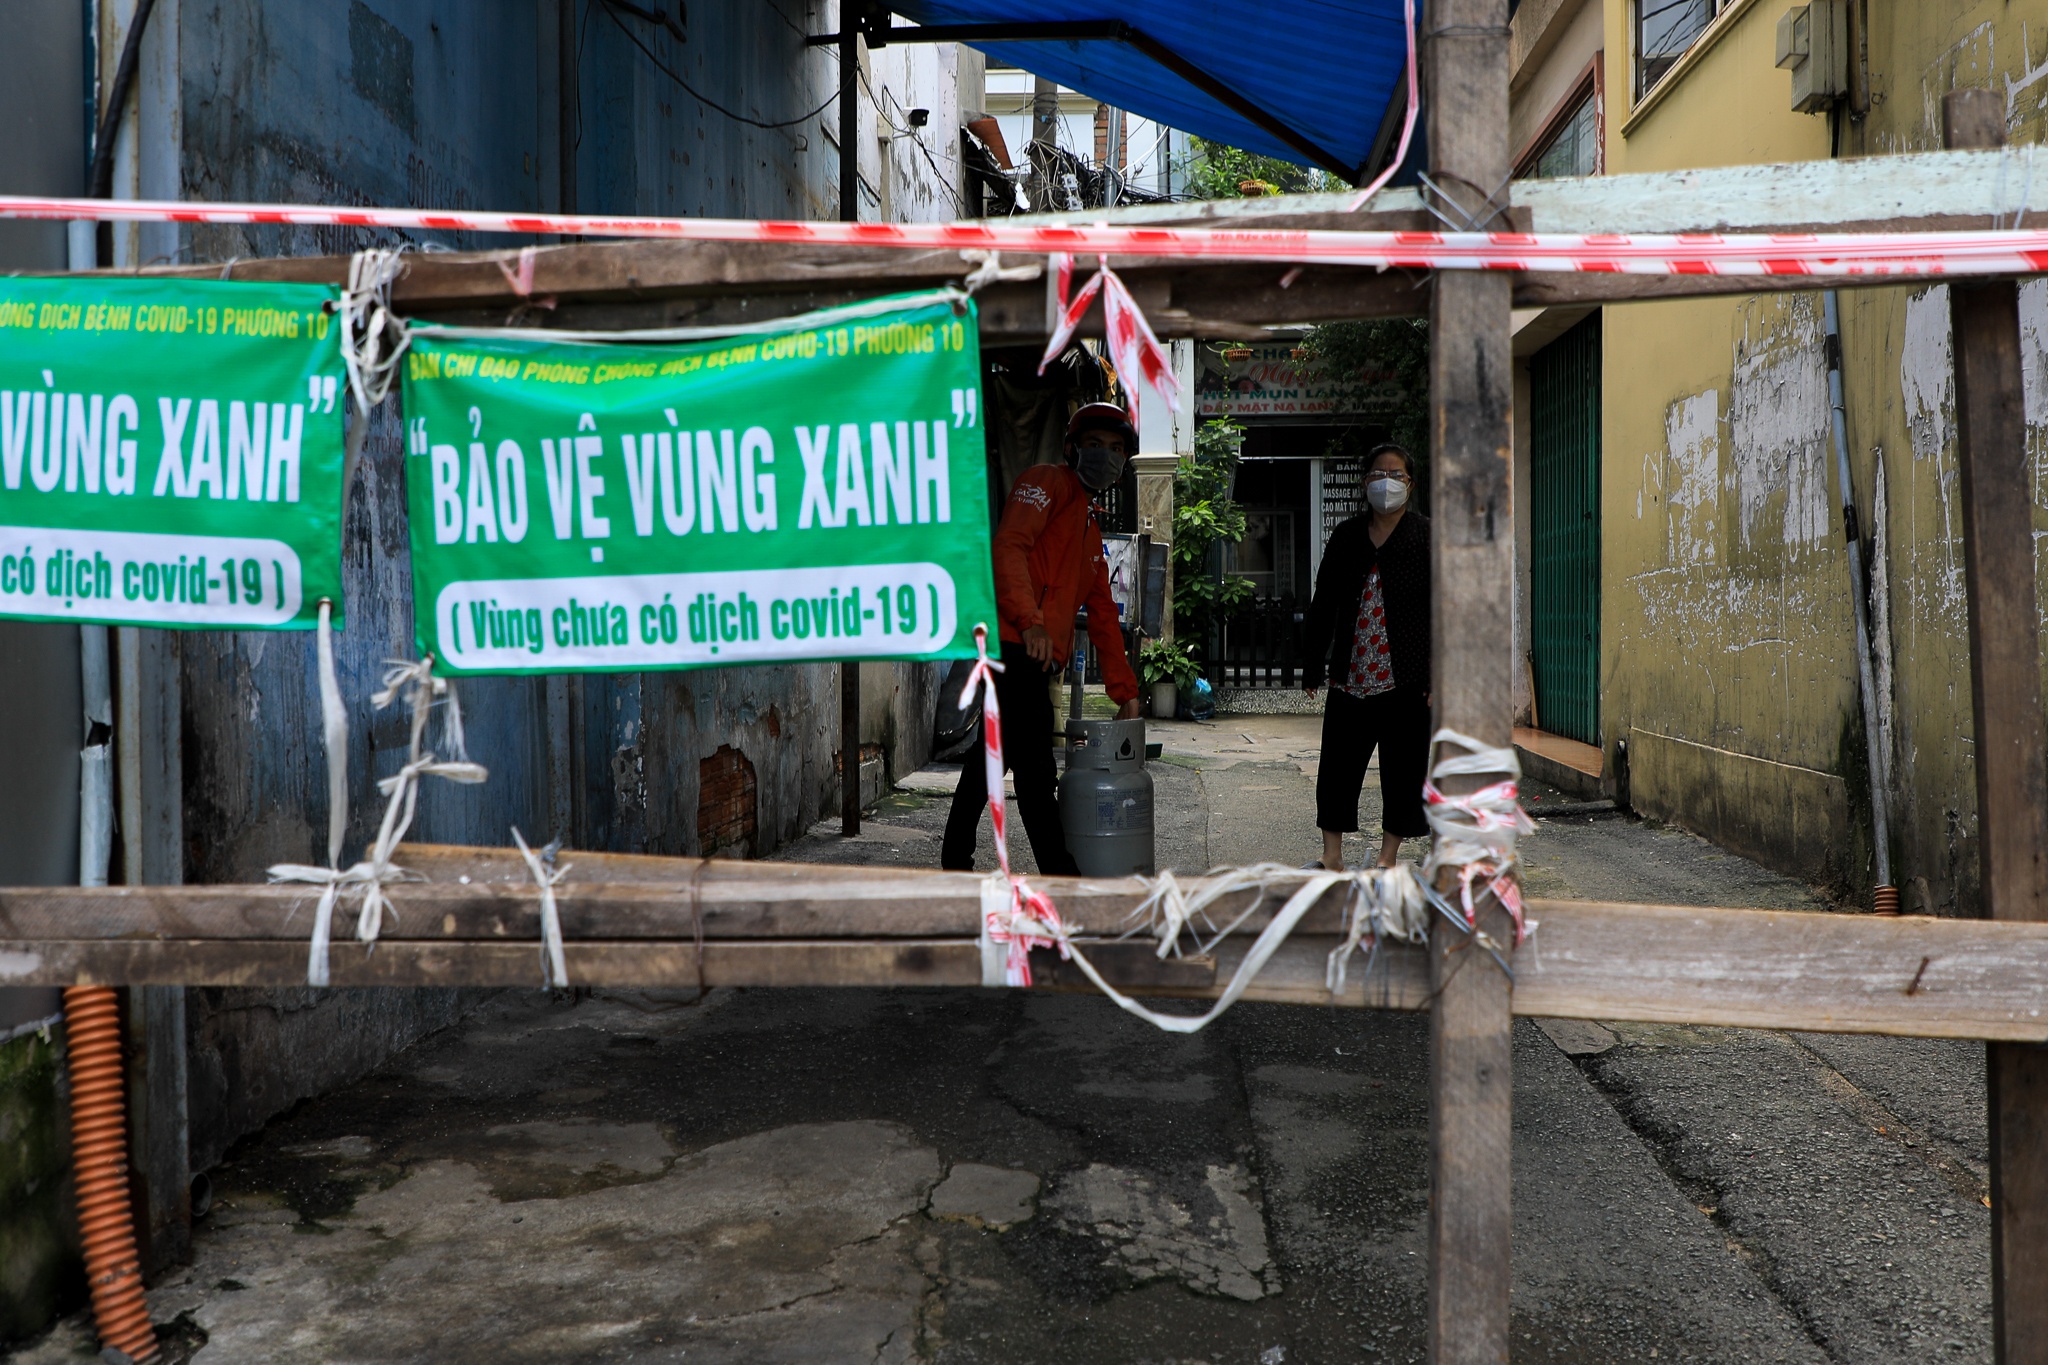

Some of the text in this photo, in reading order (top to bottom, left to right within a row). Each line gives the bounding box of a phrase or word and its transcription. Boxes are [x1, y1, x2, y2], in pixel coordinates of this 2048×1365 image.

[39, 303, 82, 335] DỊCH
[84, 300, 132, 336] BỆNH
[135, 304, 217, 335] COVID-19
[306, 312, 329, 340] 10
[409, 352, 441, 381] BAN
[761, 327, 849, 360] COVID-19
[941, 321, 964, 352] 10
[0, 369, 139, 496] VÙNG
[541, 412, 611, 563] VỆ
[621, 408, 778, 537] VÙNG
[1, 546, 35, 595] có
[46, 549, 112, 608] dịch
[123, 555, 264, 606] covid-19
[553, 599, 629, 648] chưa
[641, 593, 675, 645] có
[687, 592, 760, 655] dịch
[770, 585, 918, 640] covid-19
